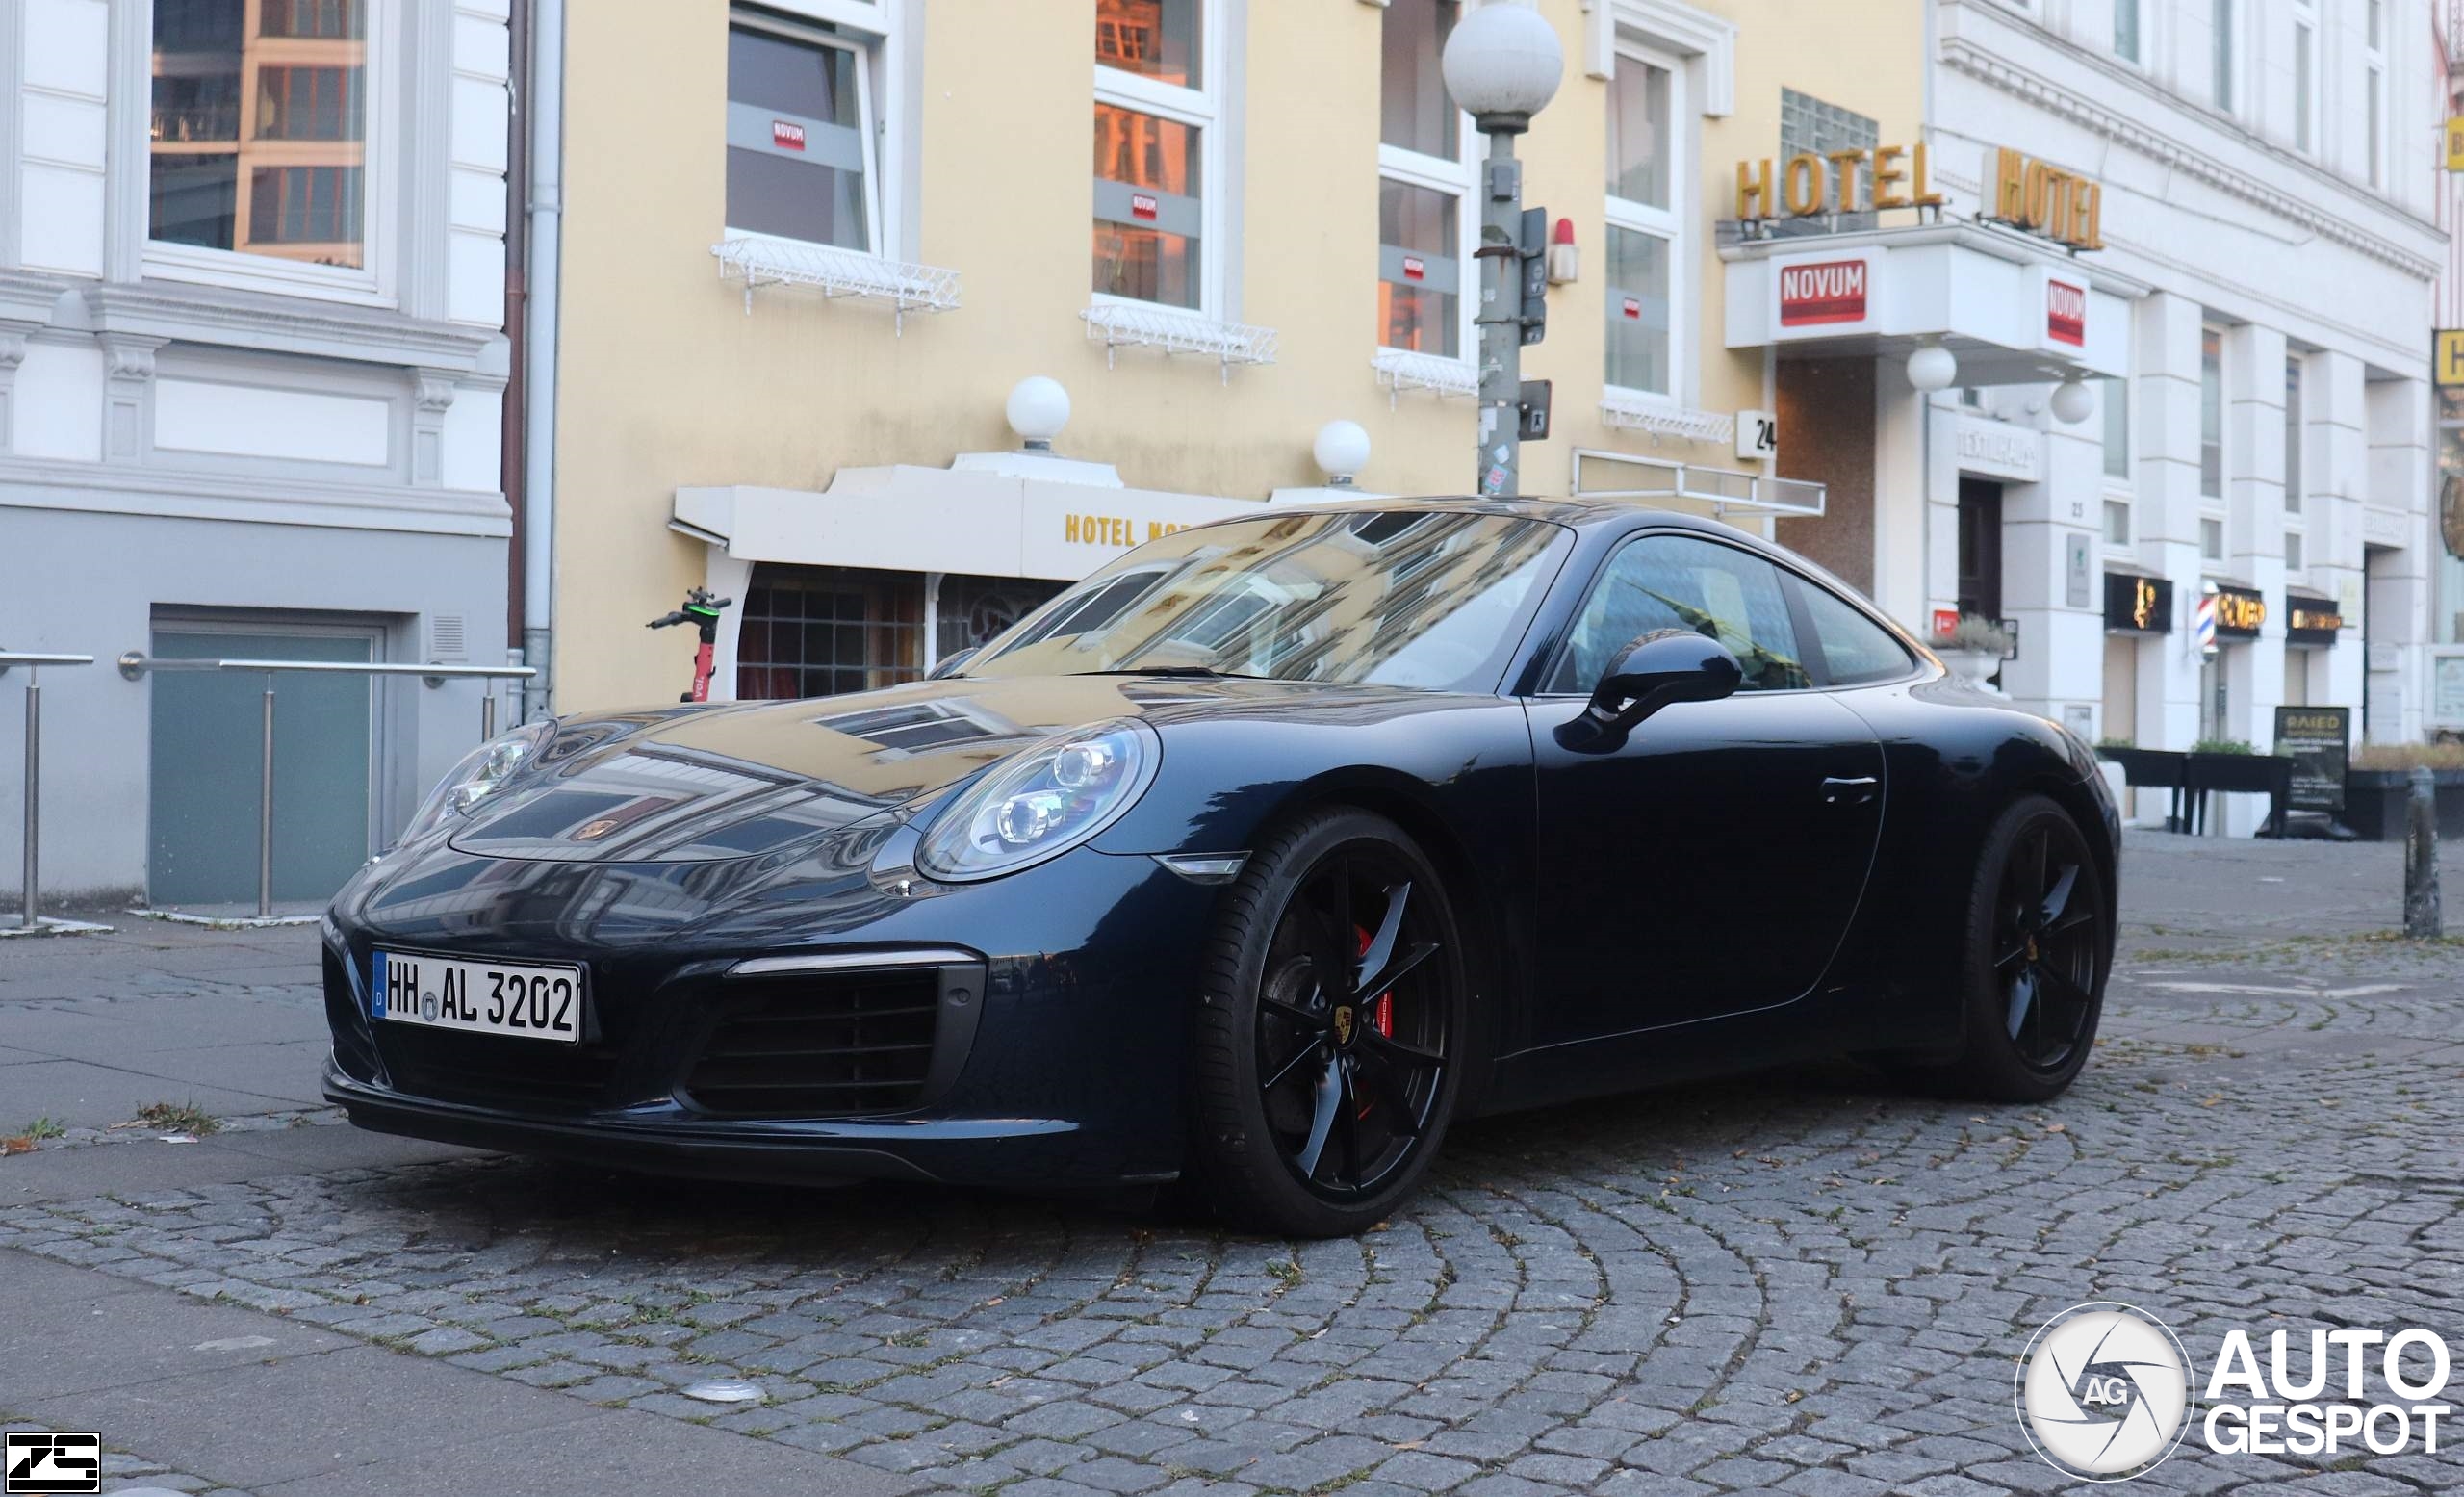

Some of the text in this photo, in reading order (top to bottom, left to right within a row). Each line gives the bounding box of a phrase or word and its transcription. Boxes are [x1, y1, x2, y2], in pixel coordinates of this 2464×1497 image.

[774, 122, 804, 142] NOVUM
[1736, 142, 1942, 220] HOTEL
[1995, 146, 2106, 250] HOTEL
[1783, 266, 1864, 301] NOVUM
[2049, 283, 2085, 321] NOVUM
[1757, 419, 1777, 451] 24
[1065, 514, 1192, 547] HOTEL NO
[376, 961, 573, 1032] D HH AL 3202
